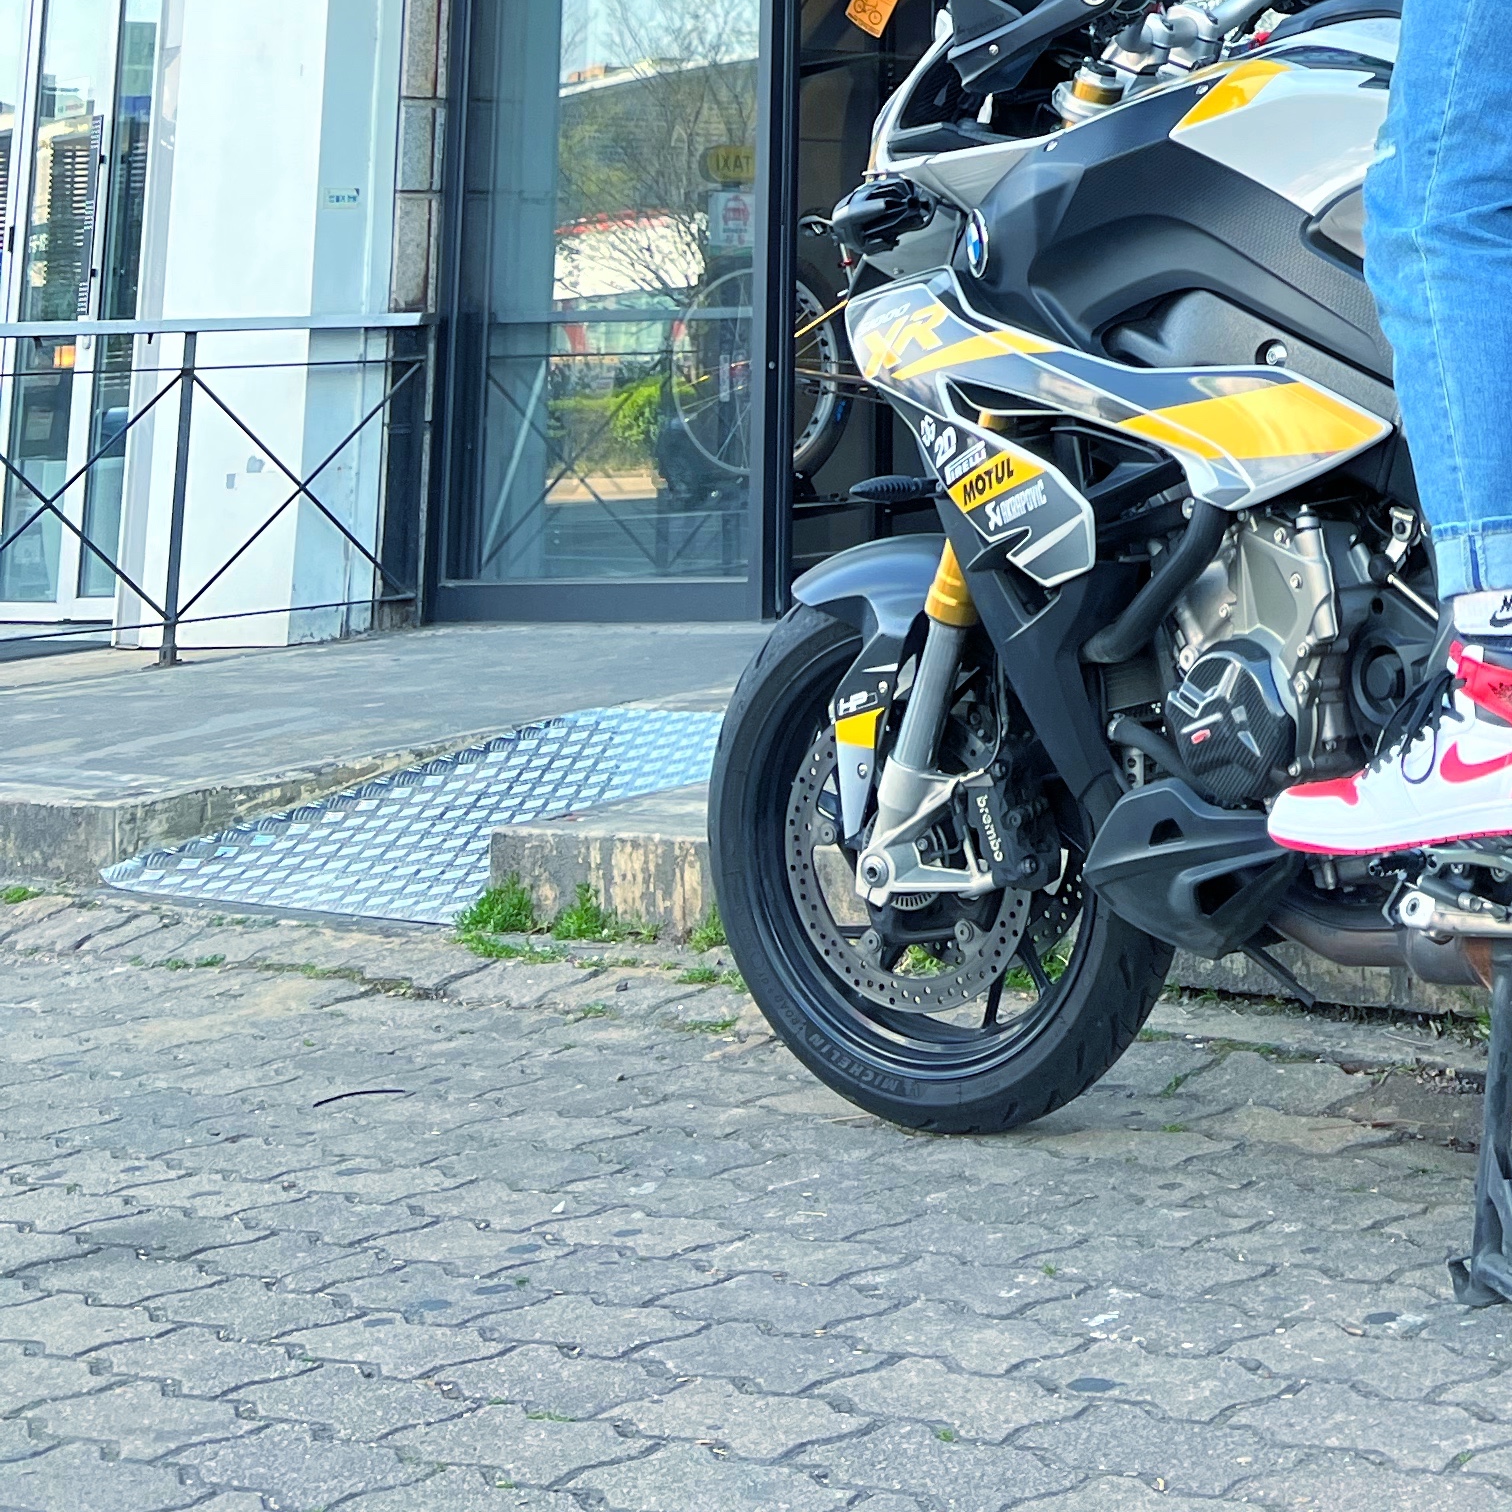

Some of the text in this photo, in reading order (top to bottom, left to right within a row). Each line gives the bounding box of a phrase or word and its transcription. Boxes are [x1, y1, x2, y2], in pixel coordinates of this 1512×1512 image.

[963, 457, 1015, 507] MOTUL
[838, 690, 869, 717] HP
[976, 794, 1004, 863] brembo
[807, 1032, 901, 1093] MICHELIN
